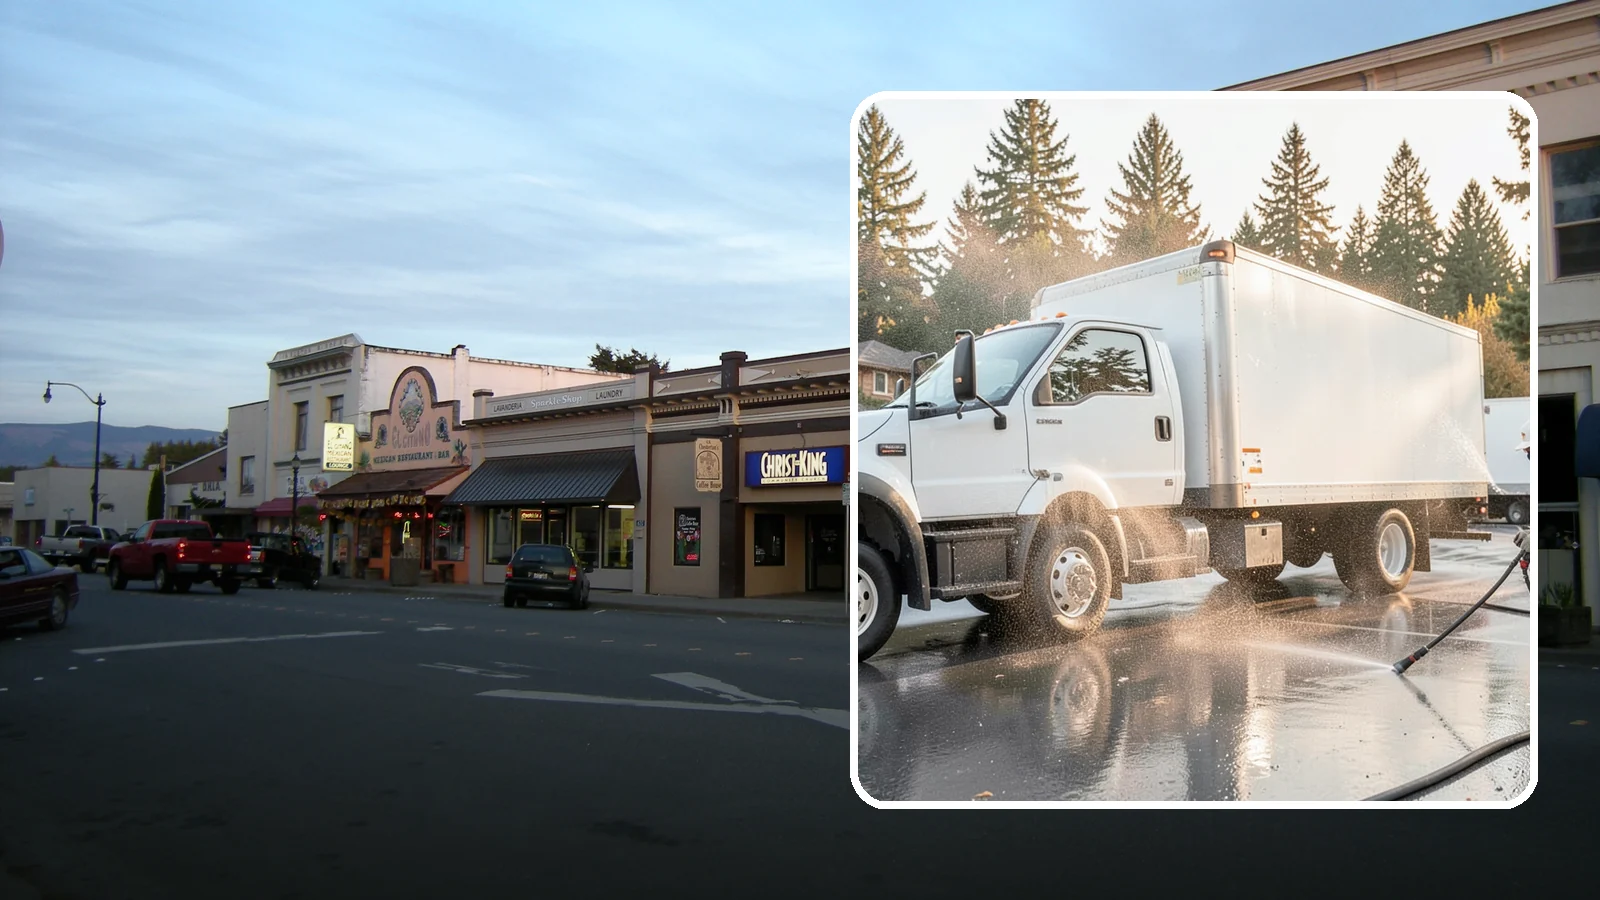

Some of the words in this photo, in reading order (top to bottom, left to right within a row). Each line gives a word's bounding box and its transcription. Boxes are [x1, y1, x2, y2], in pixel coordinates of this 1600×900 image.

[493, 402, 522, 413] LAVANDERIA
[531, 396, 560, 409] Sparkle
[562, 394, 582, 404] Shop
[595, 388, 623, 400] LAUNDRY
[373, 454, 396, 464] MEXICAN
[396, 451, 433, 462] RESTAURANT
[437, 450, 450, 459] BAR
[761, 452, 797, 477] CHRIST
[799, 450, 827, 476] KING
[696, 480, 709, 488] Coffee
[710, 480, 721, 489] House
